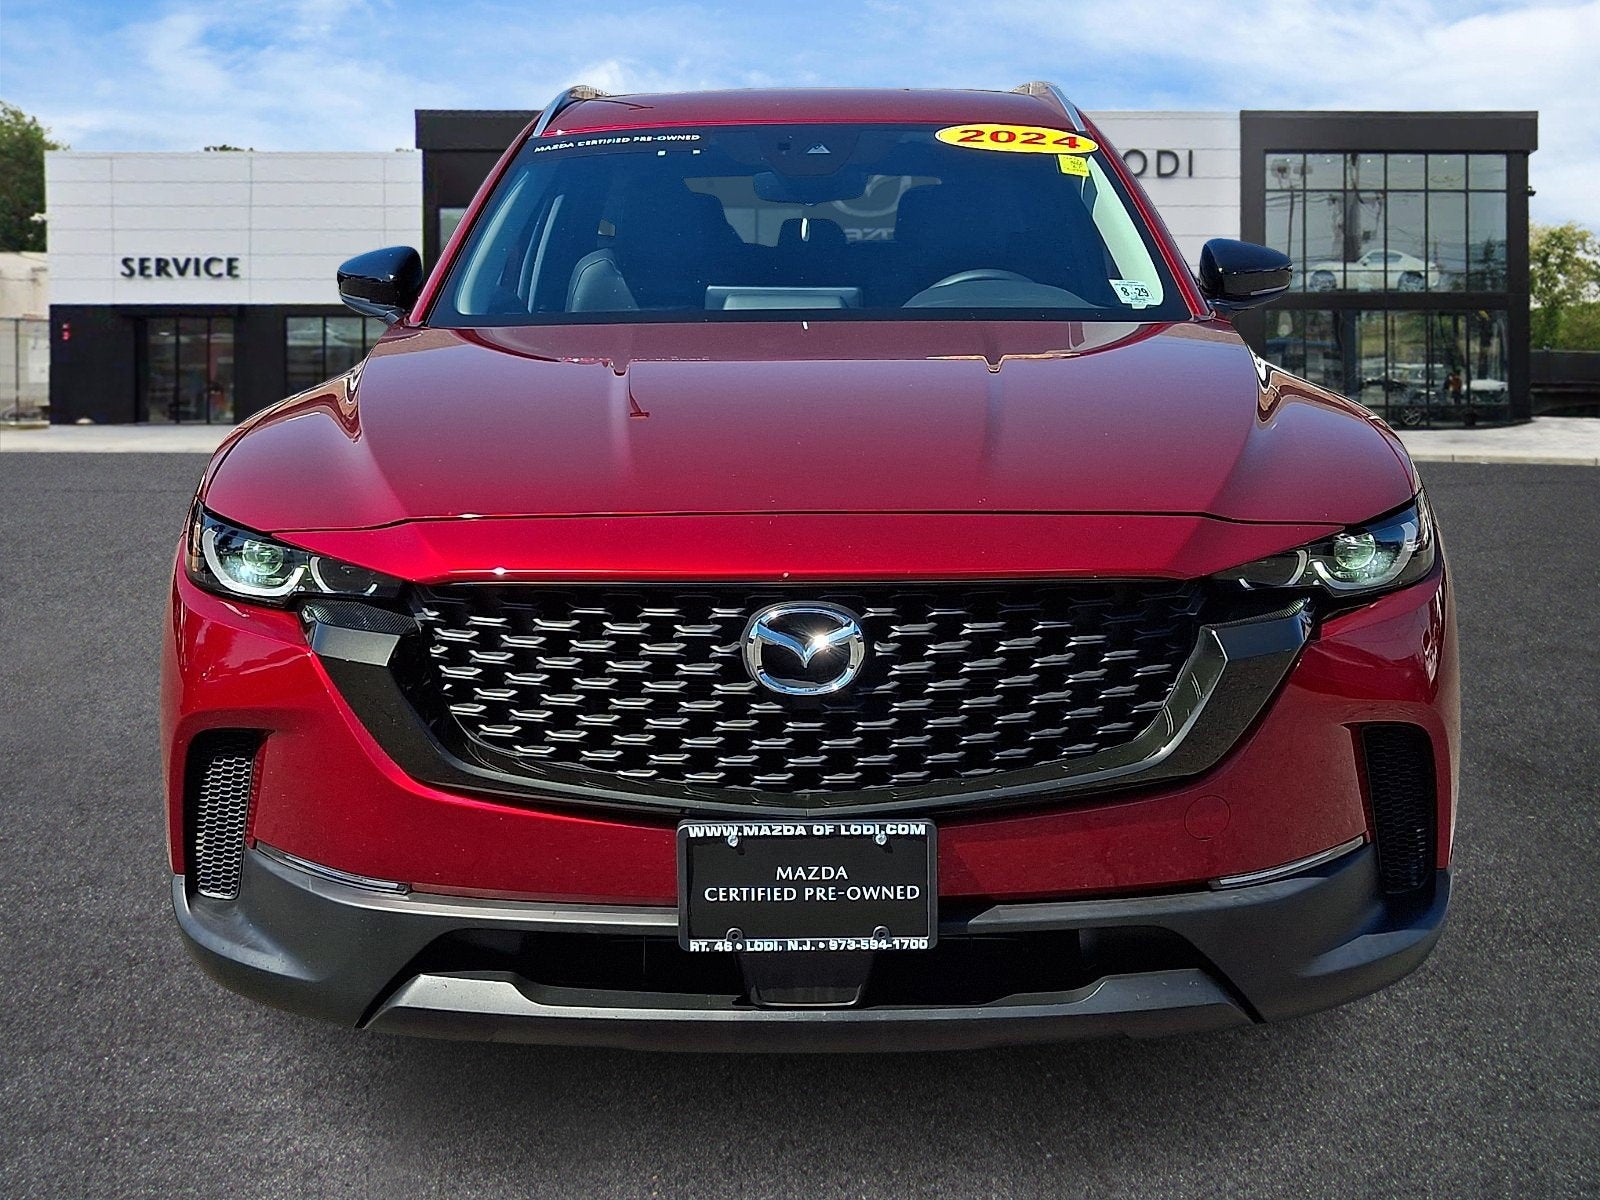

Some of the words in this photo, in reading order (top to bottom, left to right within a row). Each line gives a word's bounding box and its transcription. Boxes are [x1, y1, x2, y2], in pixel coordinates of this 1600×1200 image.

[534, 142, 575, 153] MAZDA
[577, 137, 631, 147] CERTIFIED
[633, 134, 701, 142] PRE-OWNED
[957, 129, 1081, 149] 2024
[1122, 149, 1193, 178] ODI
[120, 257, 240, 279] SERVICE
[1120, 286, 1130, 297] 8
[1134, 287, 1149, 297] 29
[688, 824, 807, 838] WWW.MAZDA
[812, 825, 835, 836] OF
[840, 824, 926, 836] LODI.COM
[775, 865, 849, 881] MAZDA
[704, 887, 797, 902] CERTIFIED
[804, 885, 920, 901] PRE-OWNED
[690, 940, 710, 952] RT.
[713, 940, 732, 952] 46
[787, 939, 816, 951] N.J.
[829, 938, 929, 950] 973-594-1700
